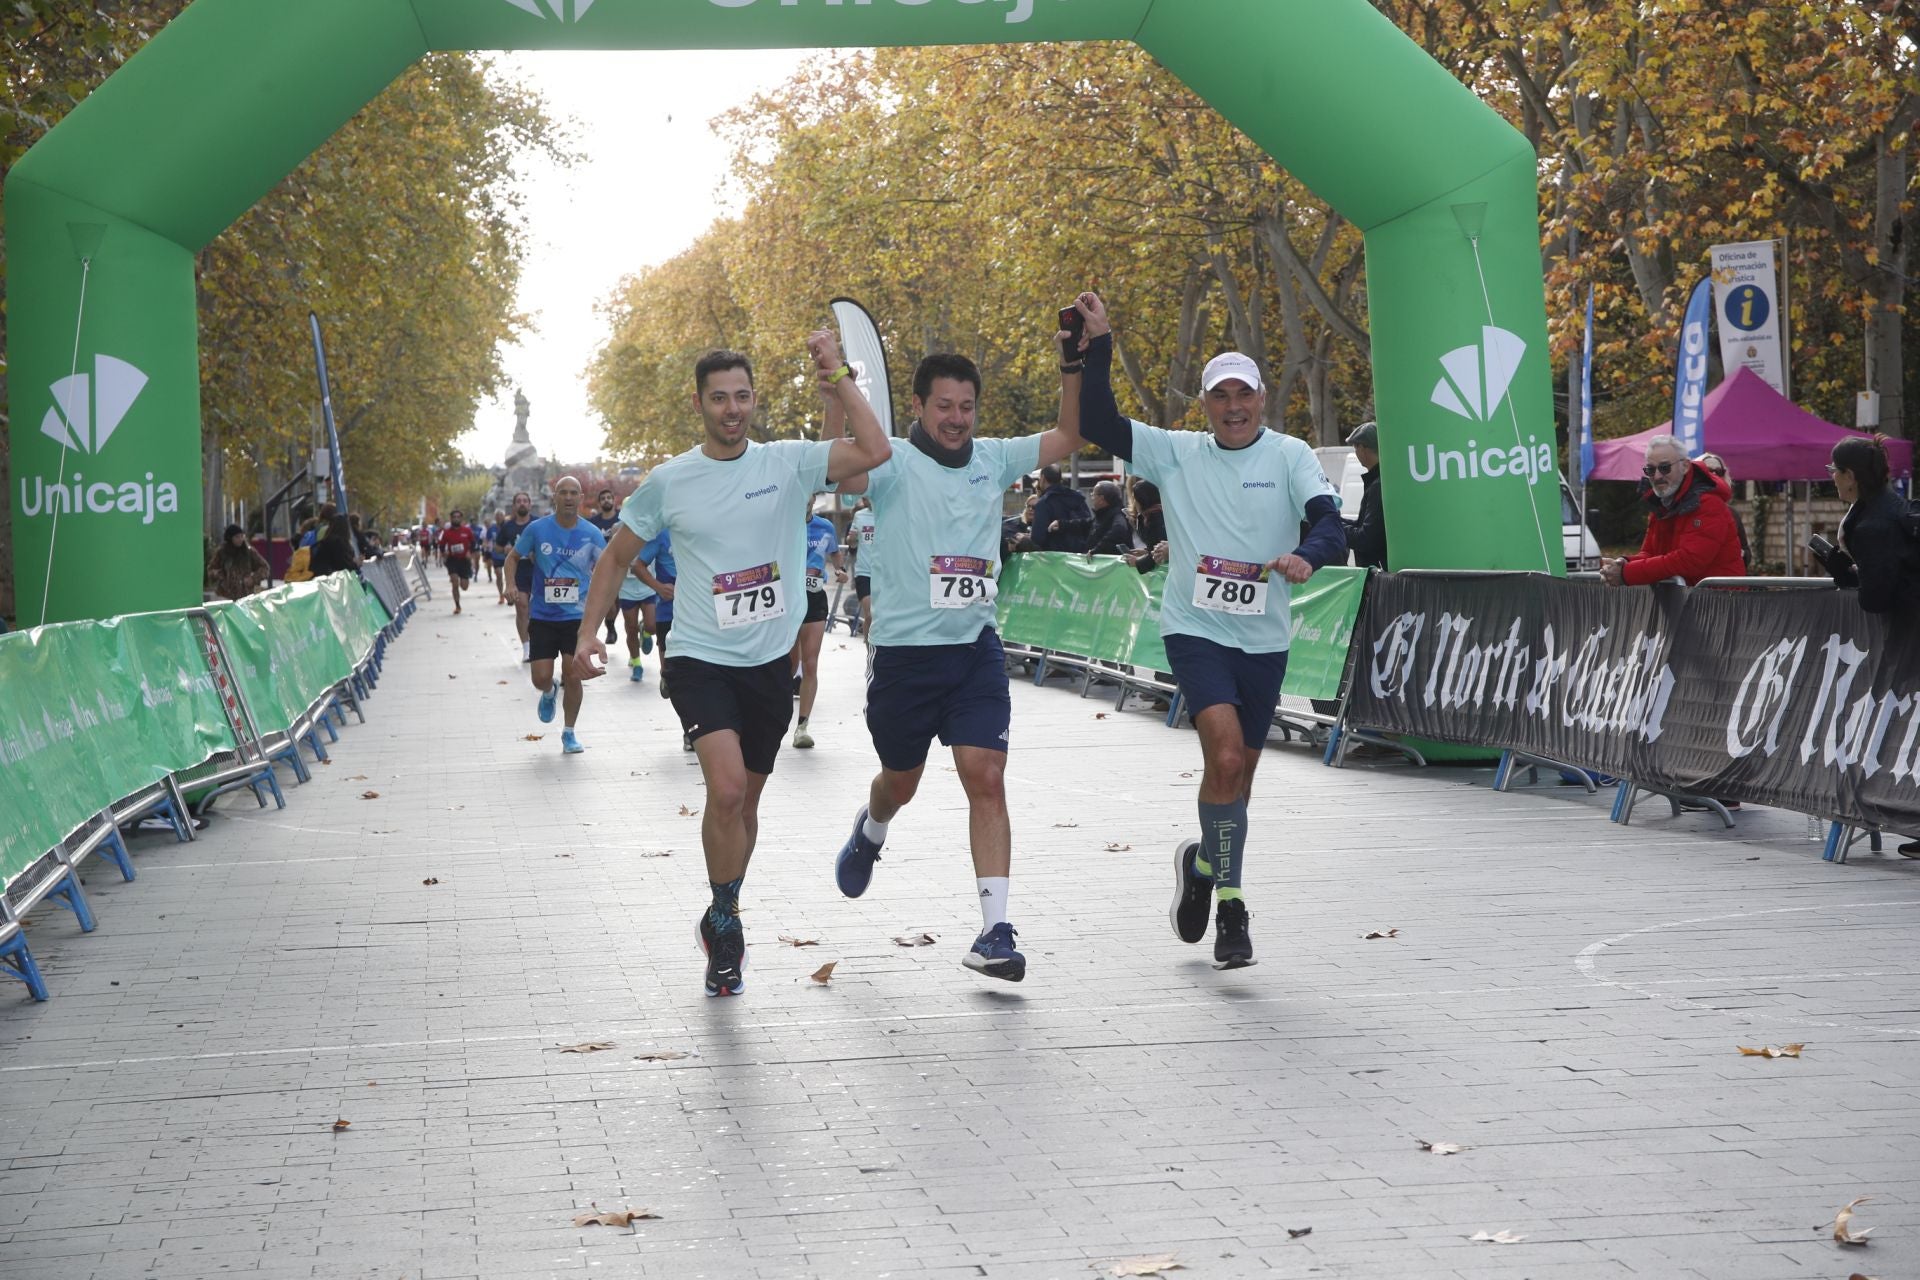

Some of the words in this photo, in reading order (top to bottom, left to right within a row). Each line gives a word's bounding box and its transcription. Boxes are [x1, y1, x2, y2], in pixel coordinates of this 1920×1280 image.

[1719, 252, 1745, 261] Oficina
[1747, 251, 1757, 259] de
[1407, 434, 1553, 485] Unicaja
[21, 471, 178, 524] Unicaja
[745, 484, 779, 500] OneHealth
[553, 587, 569, 598] 87
[725, 586, 776, 616] 779
[941, 577, 986, 598] 781
[1206, 578, 1256, 604] 780
[1370, 611, 1425, 703] El
[1424, 612, 1529, 712] Norte
[1527, 622, 1567, 720] de
[1563, 624, 1676, 744] Castilla
[1726, 635, 1808, 758] El
[1213, 820, 1237, 881] kalenji
